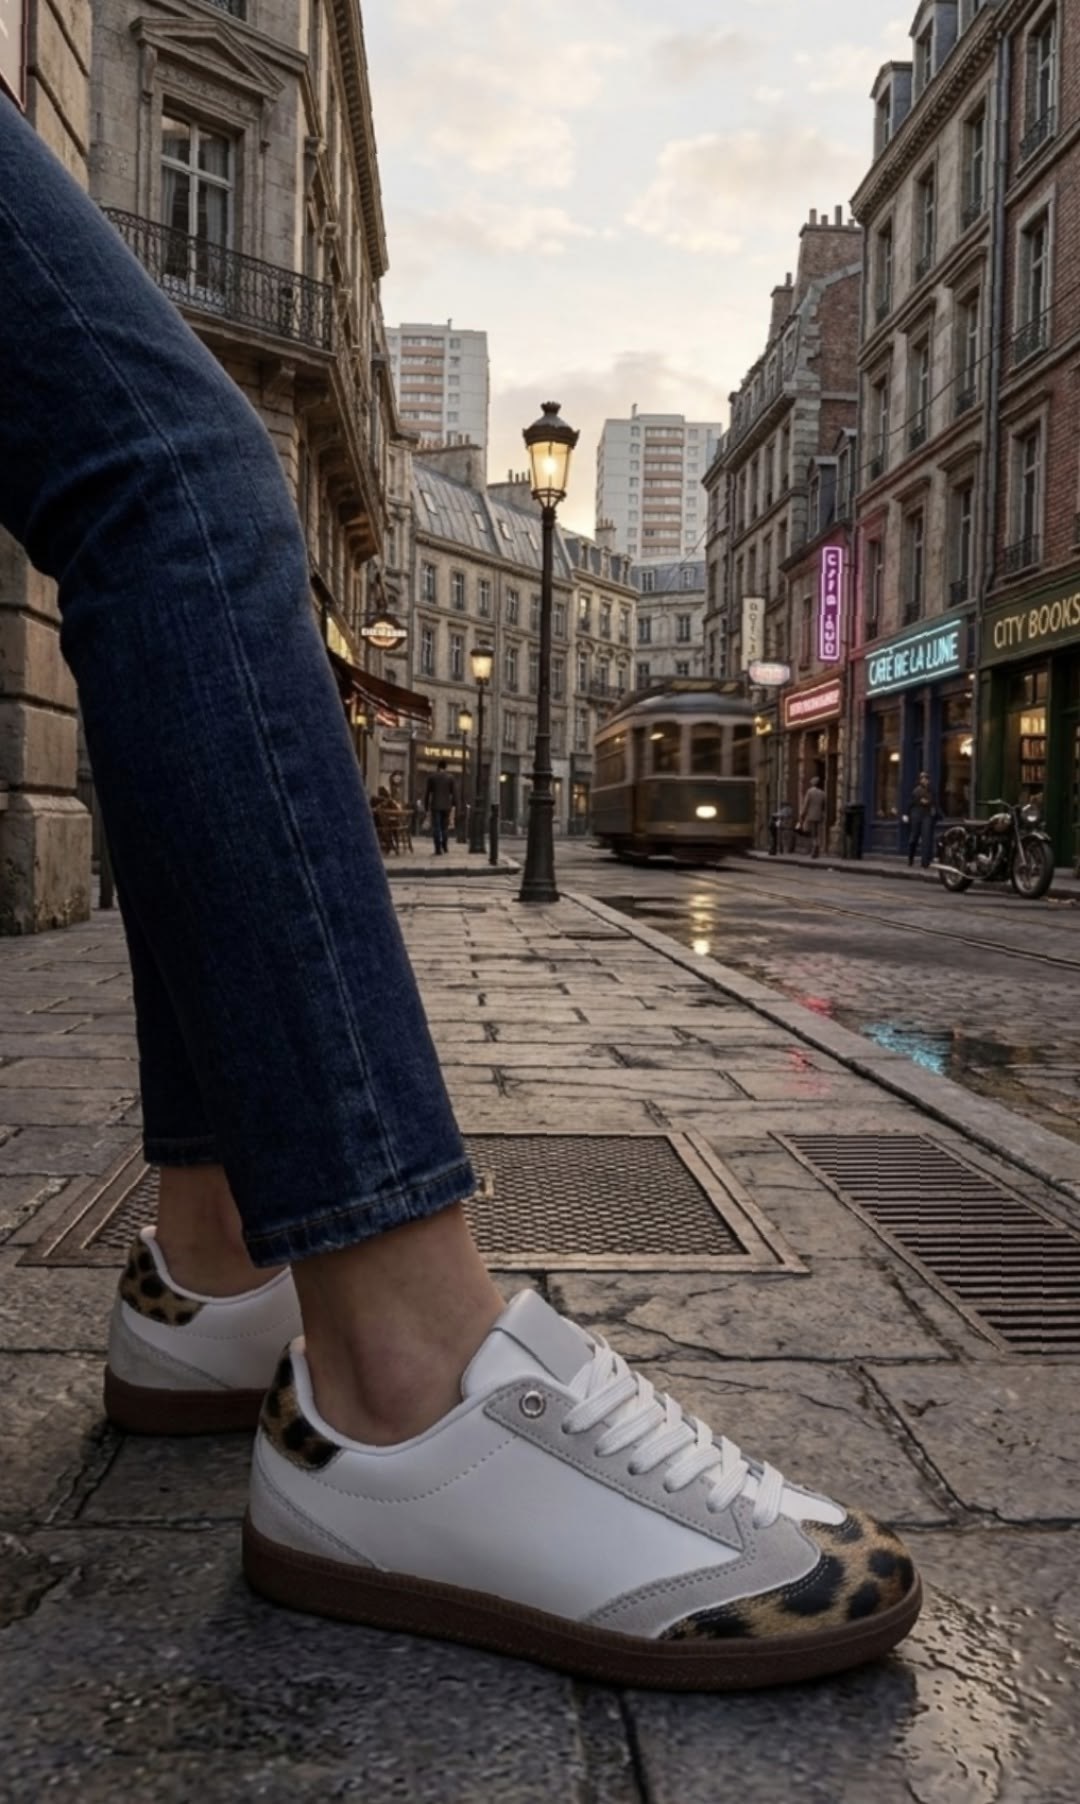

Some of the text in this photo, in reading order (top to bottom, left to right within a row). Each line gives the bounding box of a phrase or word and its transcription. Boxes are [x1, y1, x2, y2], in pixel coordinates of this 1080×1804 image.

[994, 592, 1080, 649] CITY BOOKS
[909, 645, 924, 674] LA
[926, 631, 959, 669] LUNE
